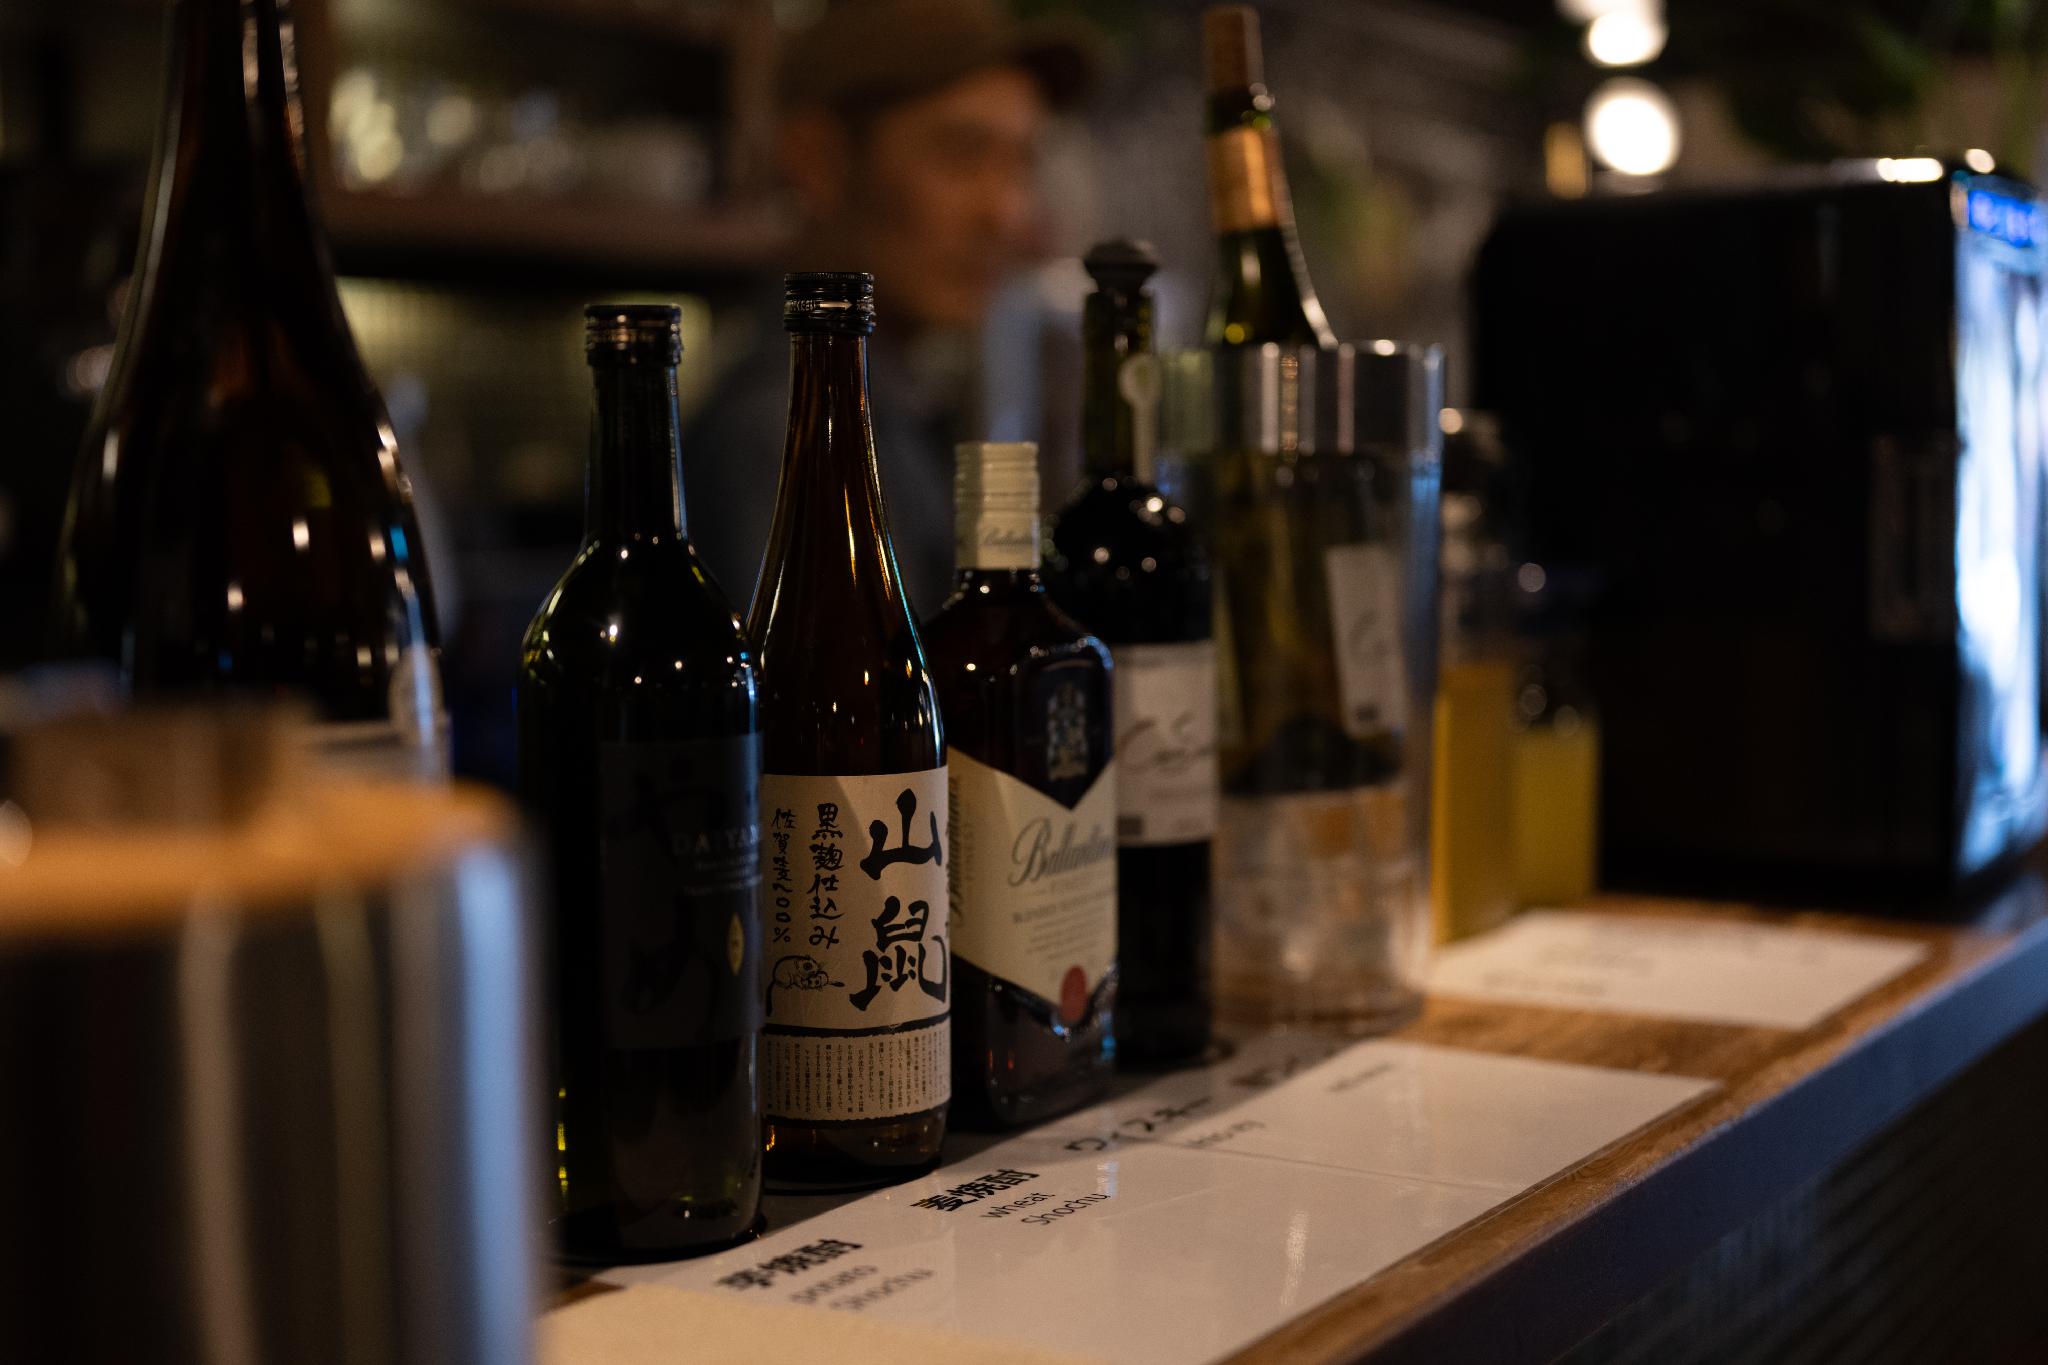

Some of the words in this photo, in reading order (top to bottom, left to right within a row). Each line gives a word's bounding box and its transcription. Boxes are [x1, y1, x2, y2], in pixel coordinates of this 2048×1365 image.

[806, 802, 846, 950] 黒麹仕込み
[849, 788, 946, 1011] 山鼠
[909, 1168, 1040, 1212] 麦焼酎
[979, 1191, 1056, 1219] wheat
